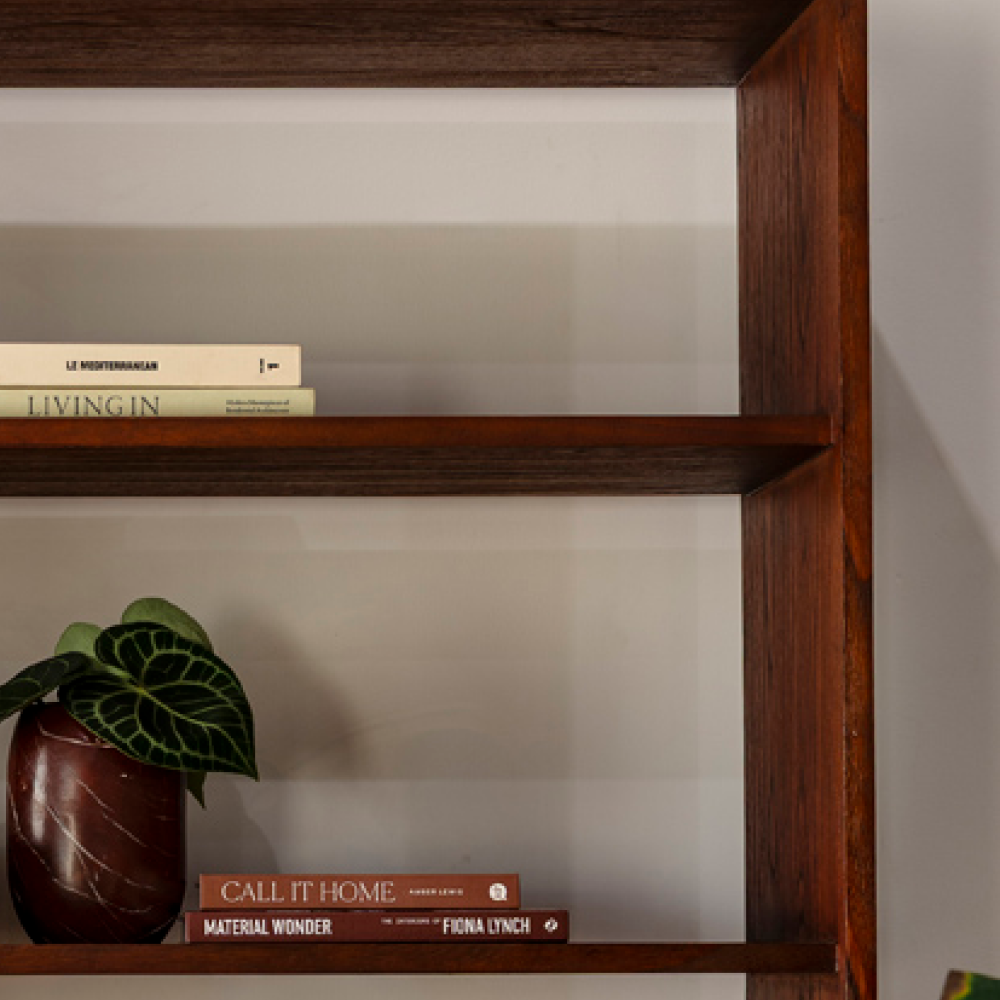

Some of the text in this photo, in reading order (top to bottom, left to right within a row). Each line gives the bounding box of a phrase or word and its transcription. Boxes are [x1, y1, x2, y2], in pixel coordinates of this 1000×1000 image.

[27, 395, 160, 416] LIVING IN
[220, 880, 396, 903] CALL IT HOME
[203, 917, 333, 936] MATERIAL WONDER
[443, 917, 531, 935] FIONA LYNCH
